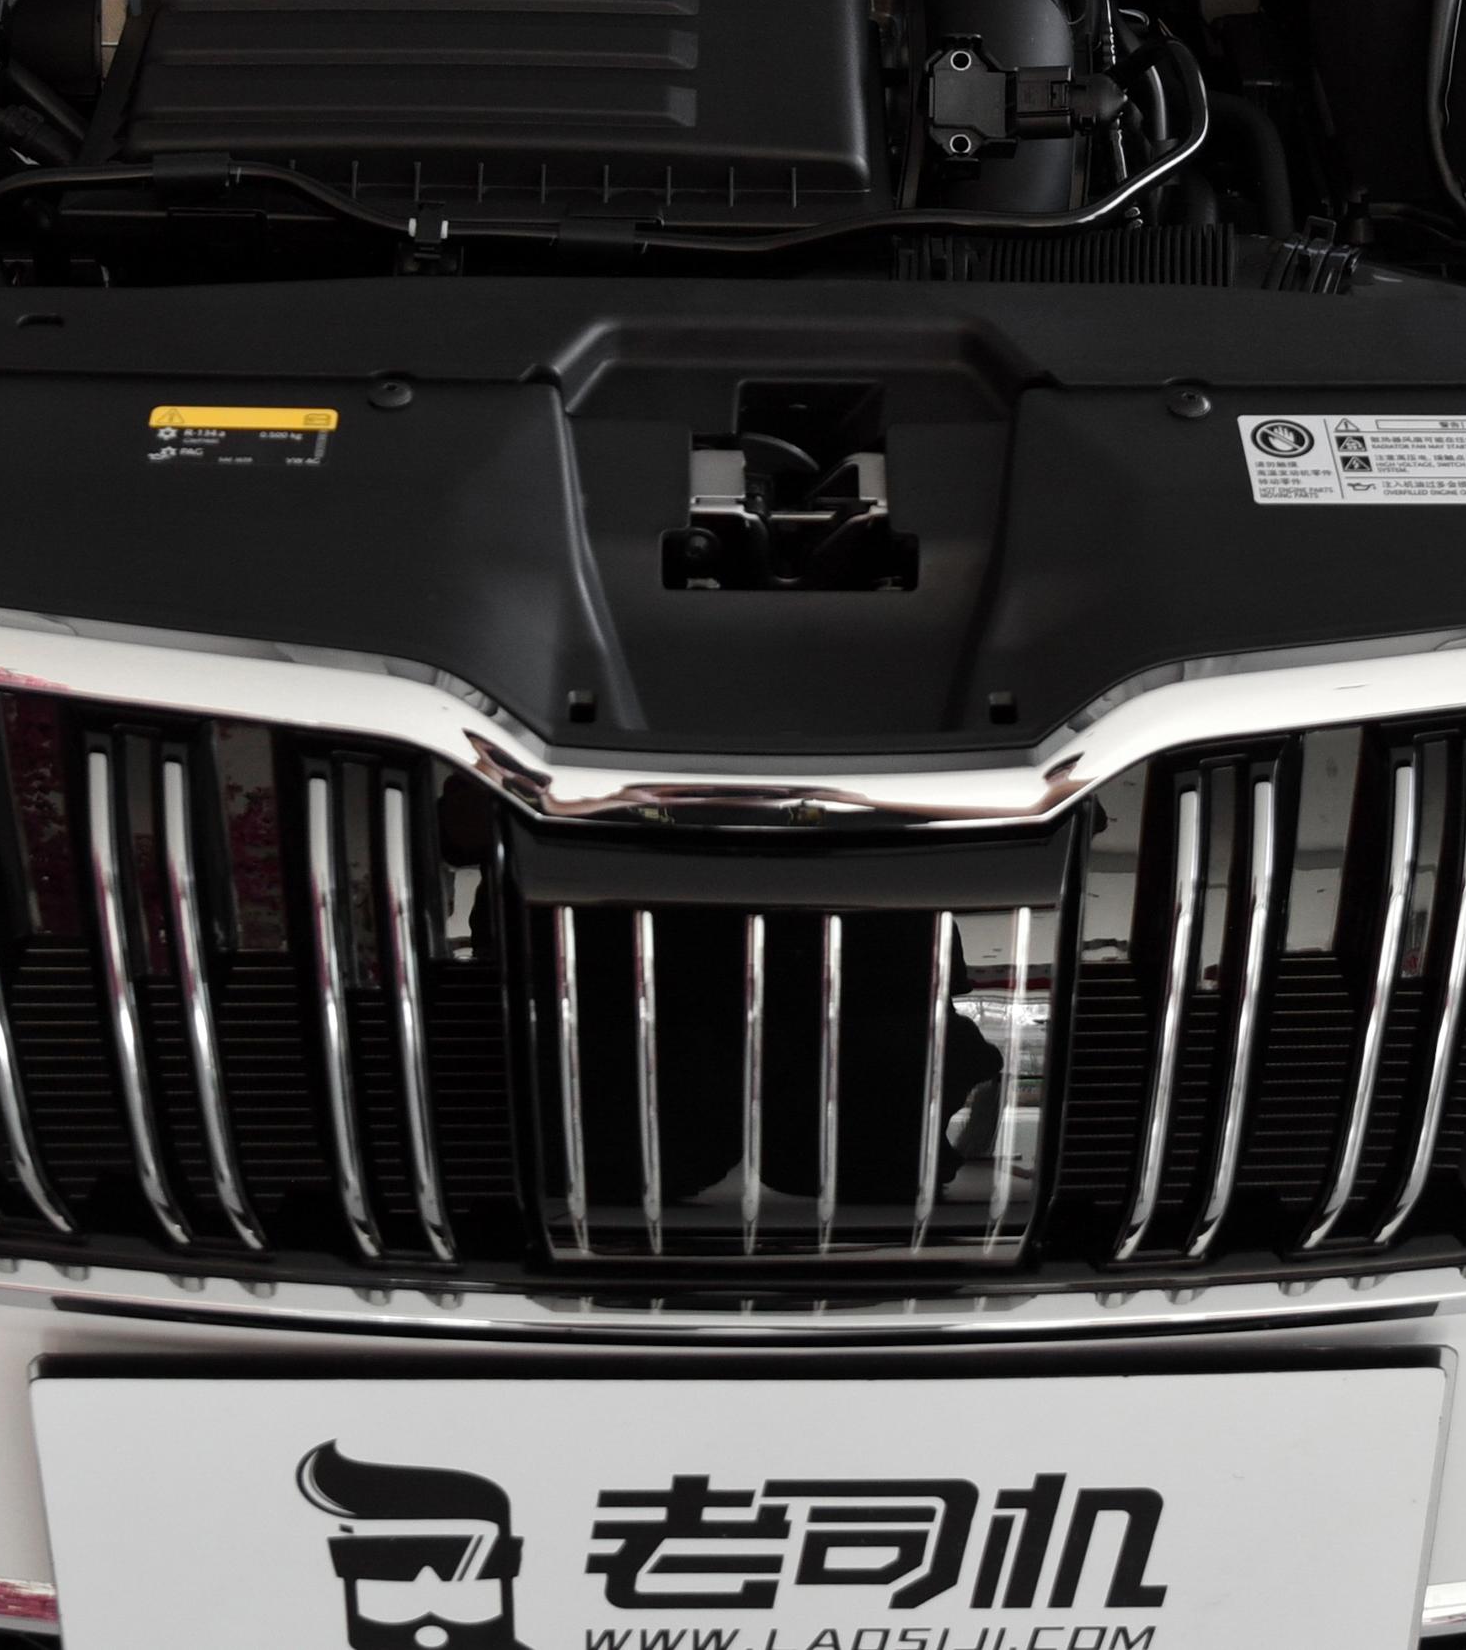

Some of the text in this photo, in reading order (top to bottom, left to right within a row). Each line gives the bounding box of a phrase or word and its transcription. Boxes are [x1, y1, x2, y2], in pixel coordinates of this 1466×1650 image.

[585, 1473, 1168, 1610] 老司机
[585, 1626, 1157, 1650] WWW.LAOSIJI.COM
